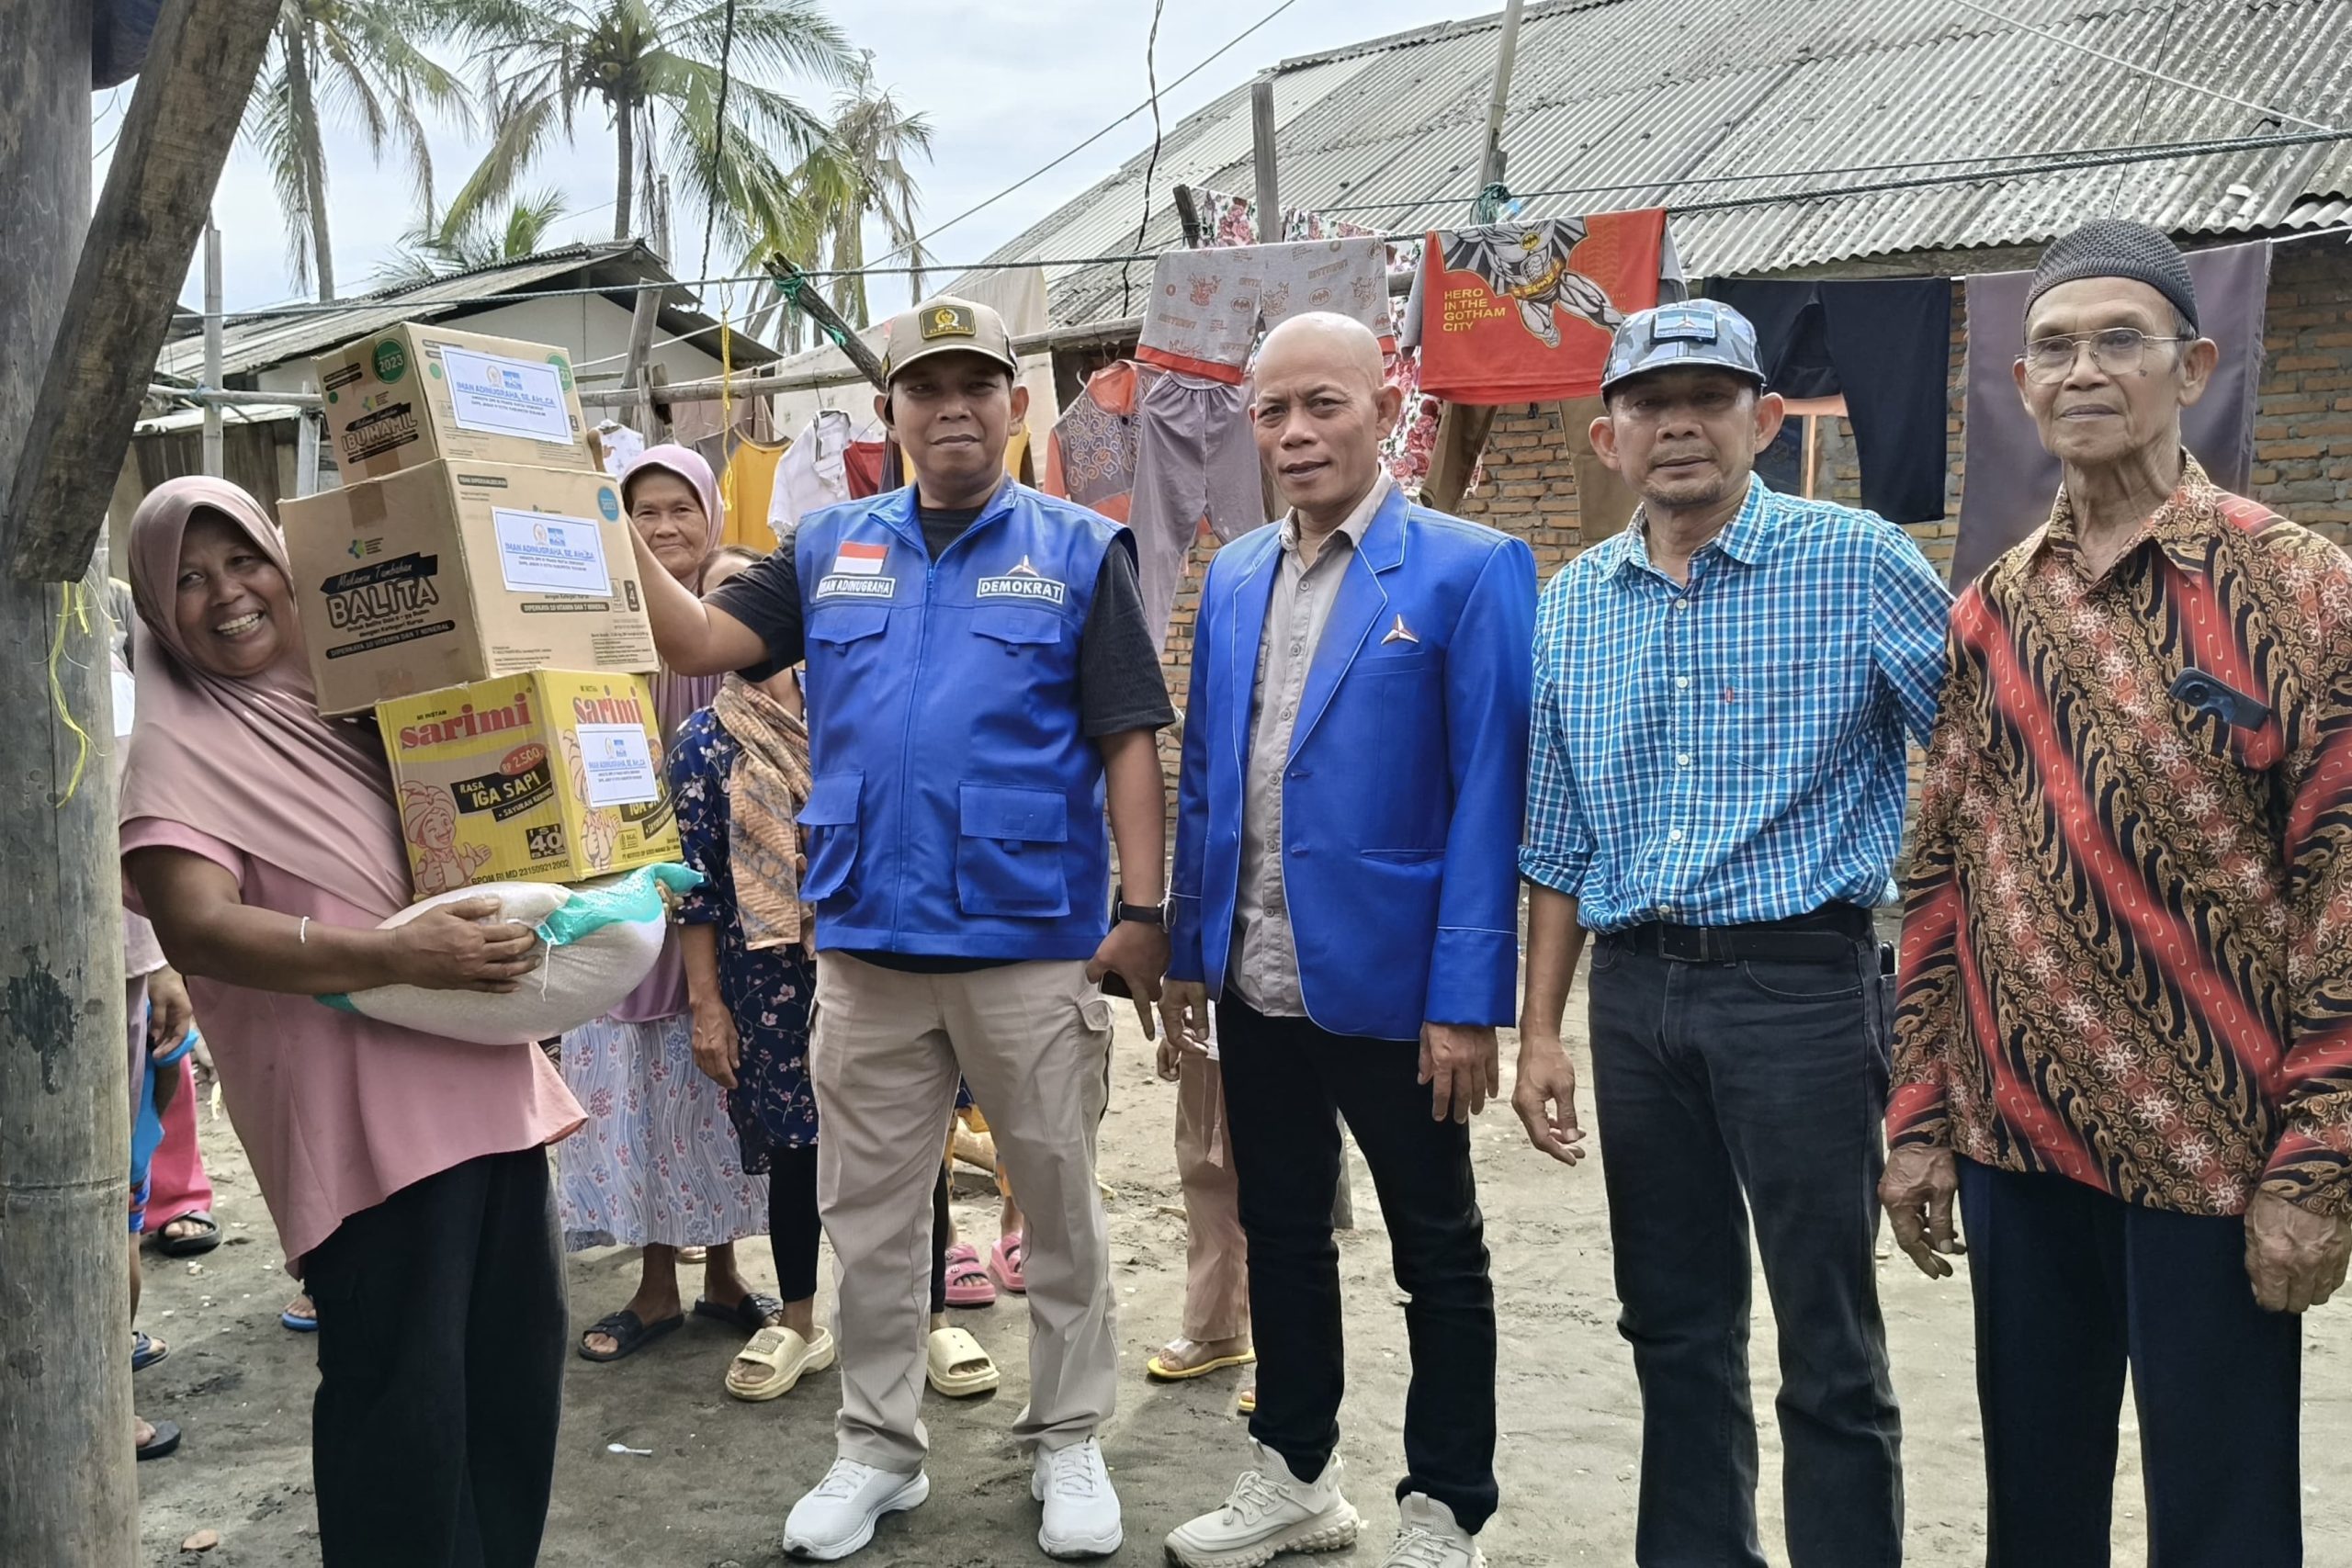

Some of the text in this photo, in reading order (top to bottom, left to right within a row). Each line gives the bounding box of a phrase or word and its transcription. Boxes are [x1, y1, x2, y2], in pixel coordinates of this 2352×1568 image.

[1444, 288, 1484, 299] HERO
[1444, 299, 1488, 310] IN THE
[1443, 307, 1506, 321] GOTHAM
[1442, 321, 1474, 332] CITY
[378, 354, 404, 373] 2023
[341, 429, 368, 452] IBU
[368, 411, 418, 442] HAMIL
[837, 580, 890, 594] ADINUGRAHA
[981, 581, 1061, 601] DEMOKRAT
[326, 575, 439, 628] BALITA
[573, 684, 646, 725] sarimi
[400, 693, 533, 750] sarimi
[460, 781, 485, 794] RASA
[472, 771, 541, 808] IGA SAPI
[529, 825, 560, 837] ISI
[530, 831, 564, 852] 40
[471, 874, 495, 885] BPOM
[496, 873, 504, 881] RI
[505, 869, 518, 879] MD
